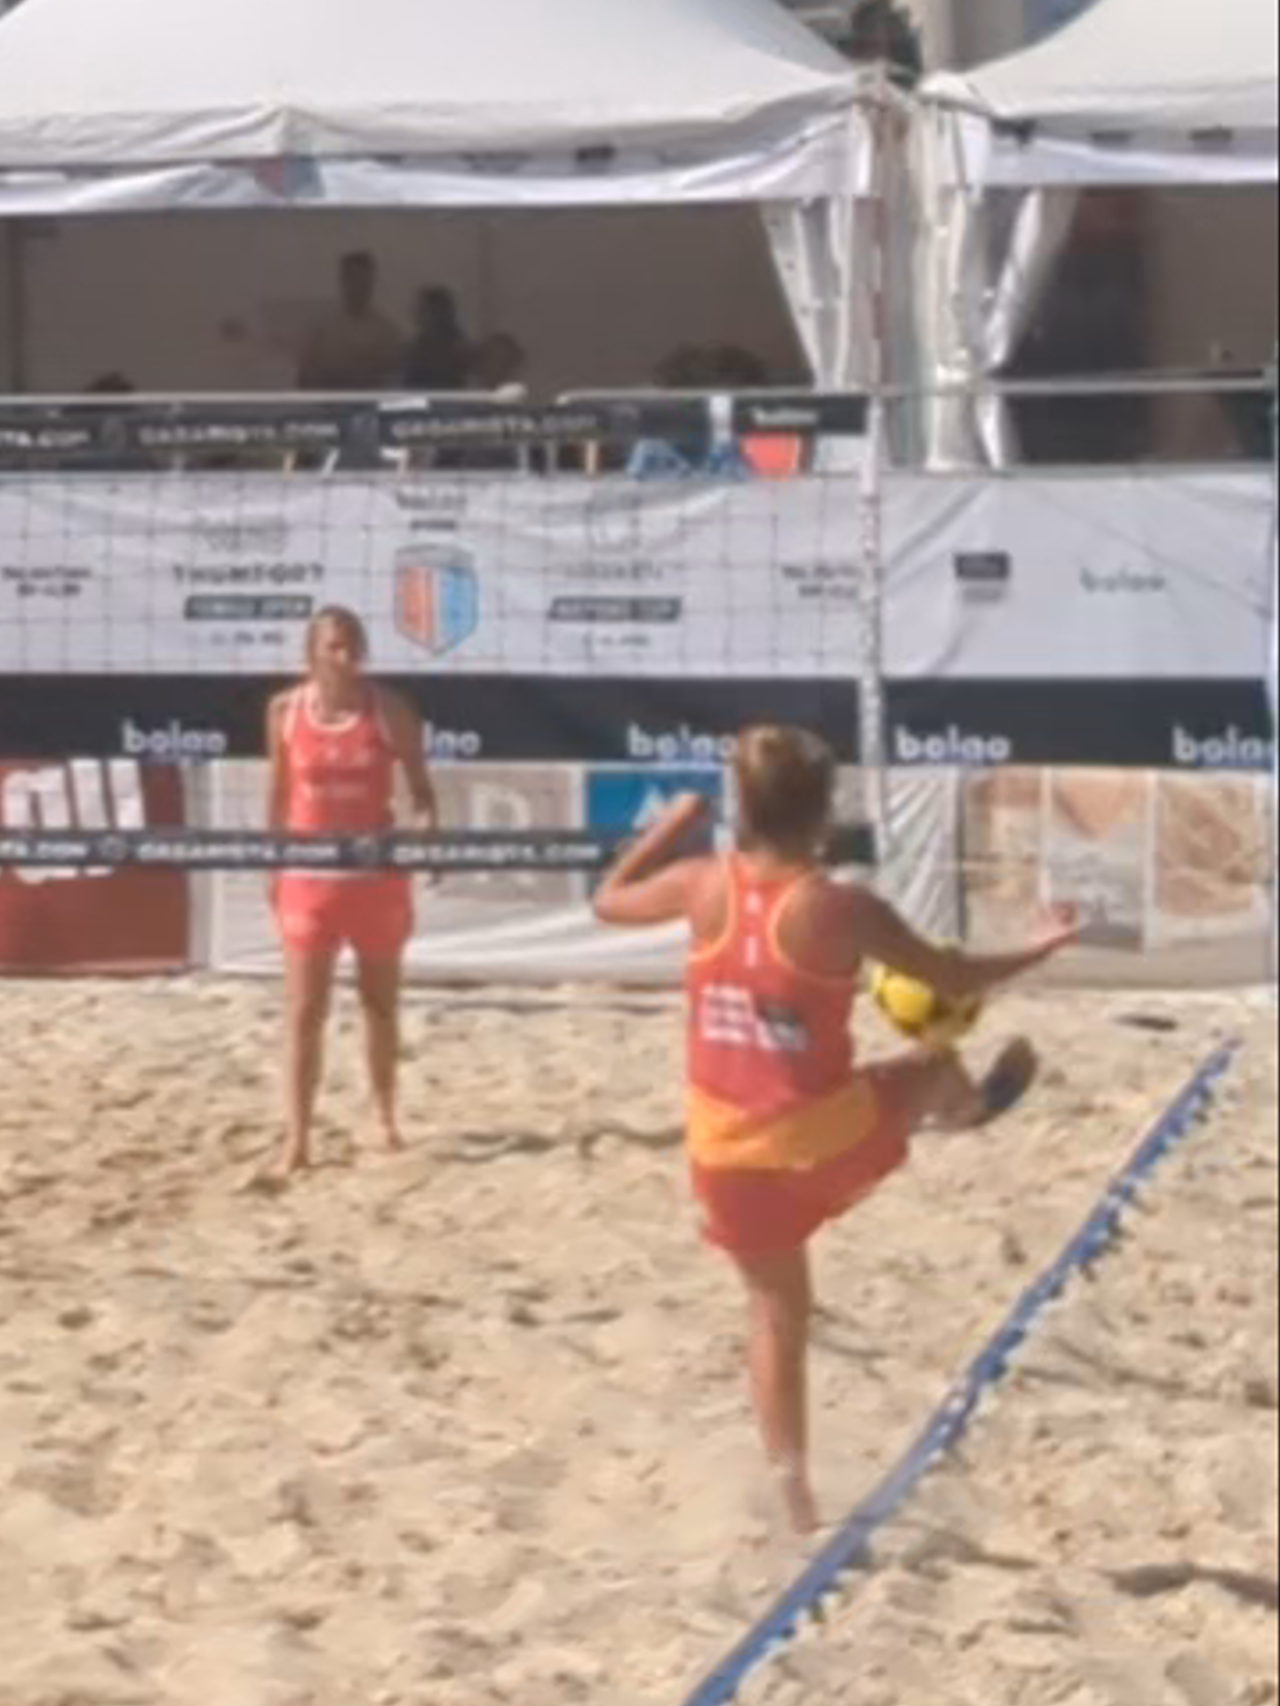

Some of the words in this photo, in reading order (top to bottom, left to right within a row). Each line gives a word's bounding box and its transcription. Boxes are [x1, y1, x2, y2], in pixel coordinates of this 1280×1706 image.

[122, 717, 229, 754] bolao
[422, 718, 483, 756] lao
[895, 724, 1012, 762] bolao
